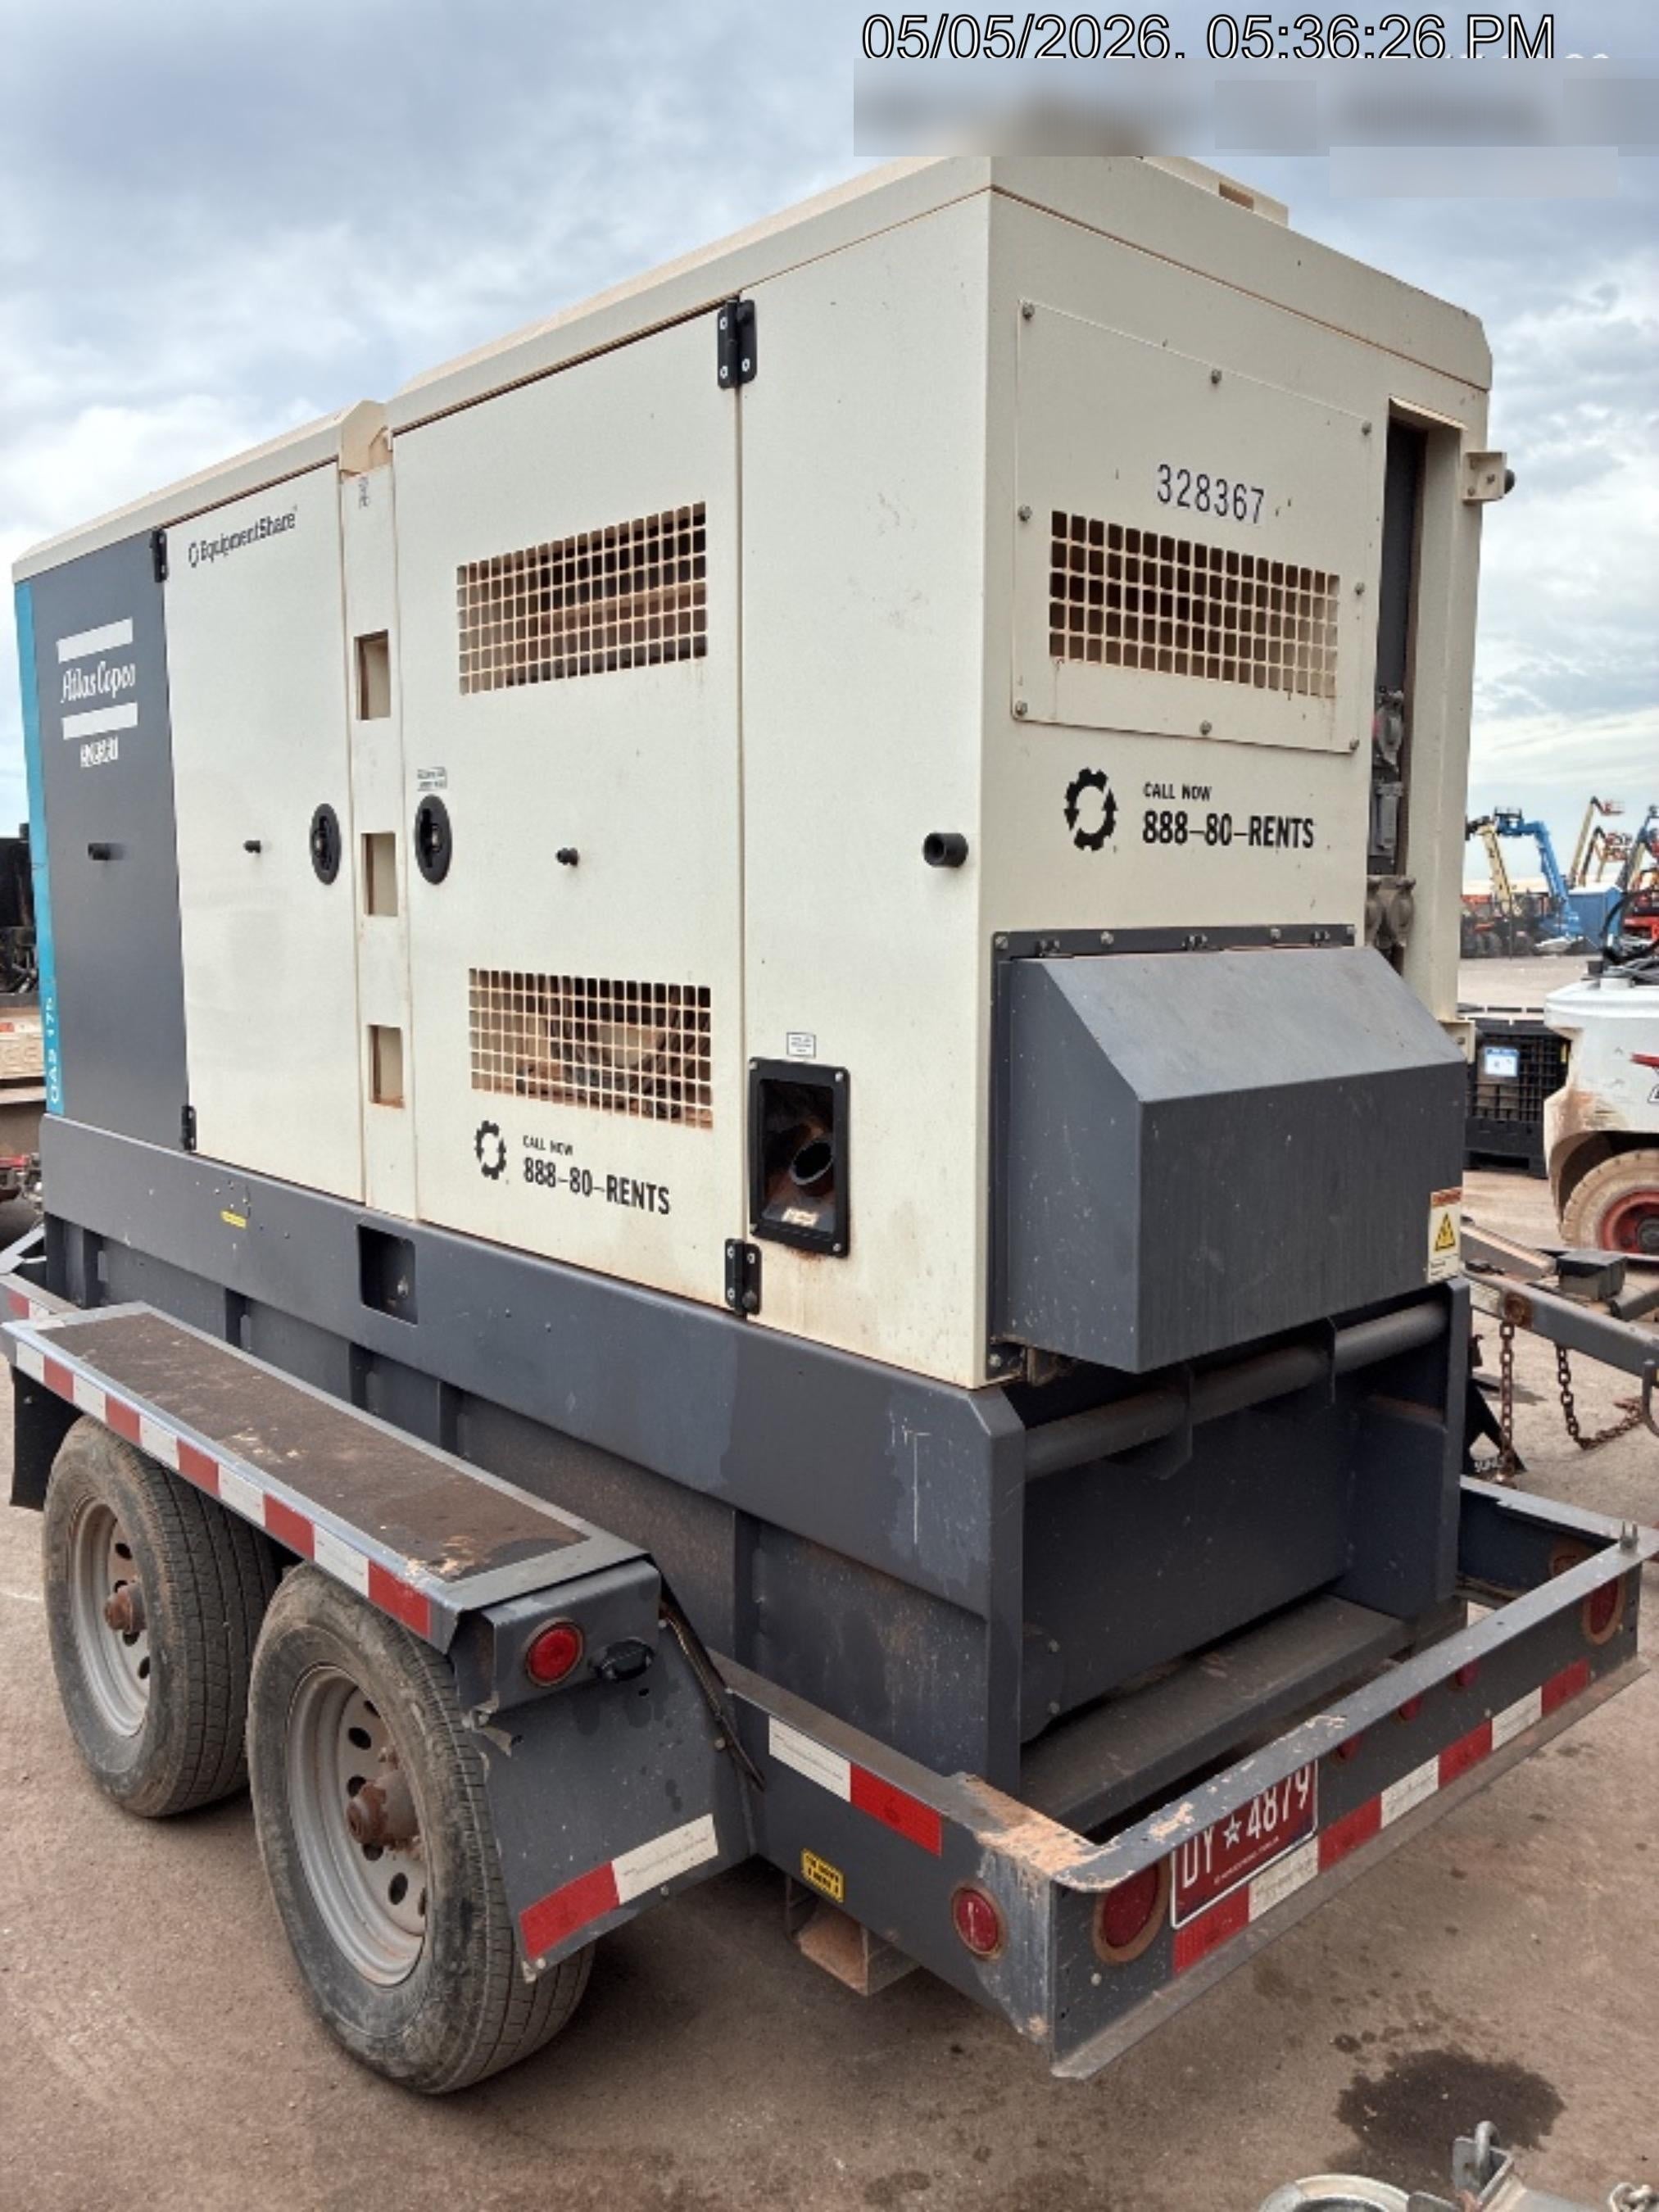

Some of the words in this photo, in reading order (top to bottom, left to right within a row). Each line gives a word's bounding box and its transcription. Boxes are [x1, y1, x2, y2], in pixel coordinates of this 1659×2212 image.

[1157, 463, 1265, 524] 328367
[1143, 782, 1175, 800] CALL
[1181, 783, 1213, 802] NOW
[1142, 810, 1315, 849] 888-80-RENTS
[523, 1135, 546, 1151] CALL
[550, 1140, 574, 1157] NOW
[523, 1157, 671, 1215] 888-80-RENTS
